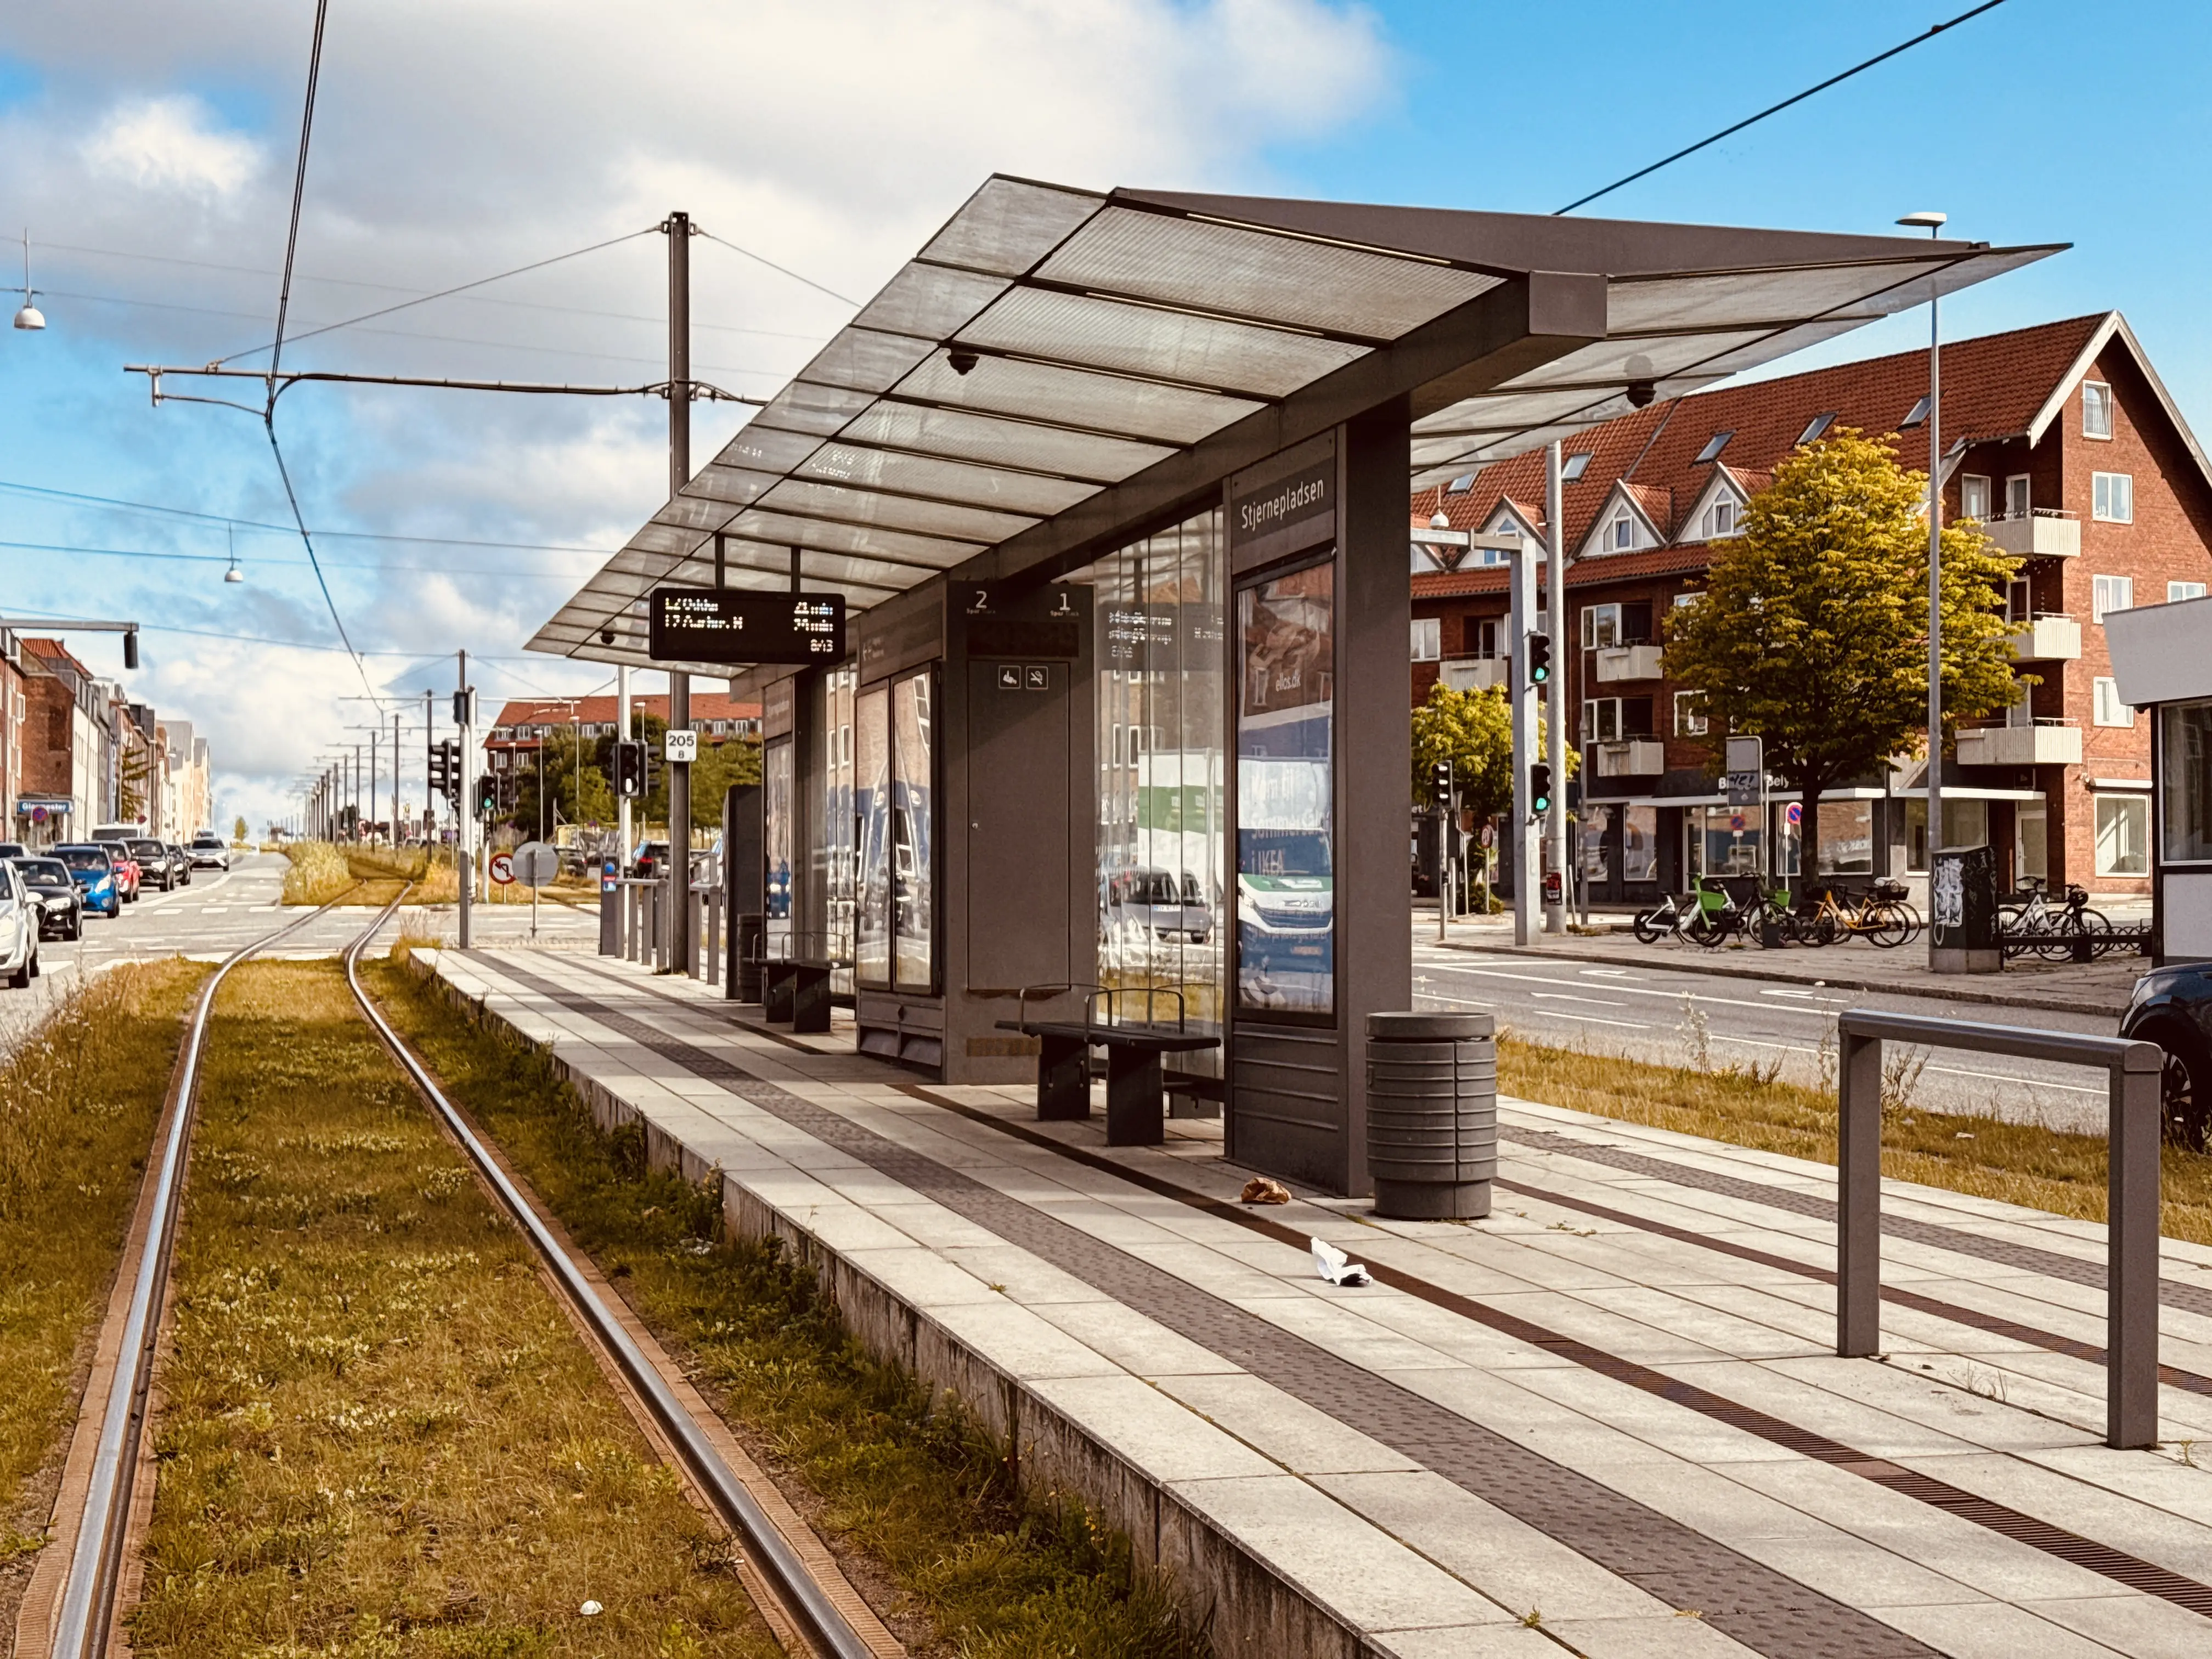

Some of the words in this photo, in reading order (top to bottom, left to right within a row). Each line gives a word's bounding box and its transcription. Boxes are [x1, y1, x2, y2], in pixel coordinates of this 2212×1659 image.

[1242, 479, 1324, 532] Stjernepladsen
[975, 591, 988, 609] 2
[1059, 593, 1071, 611] 1
[668, 735, 695, 747] 205
[1258, 848, 1285, 876] IKEA
